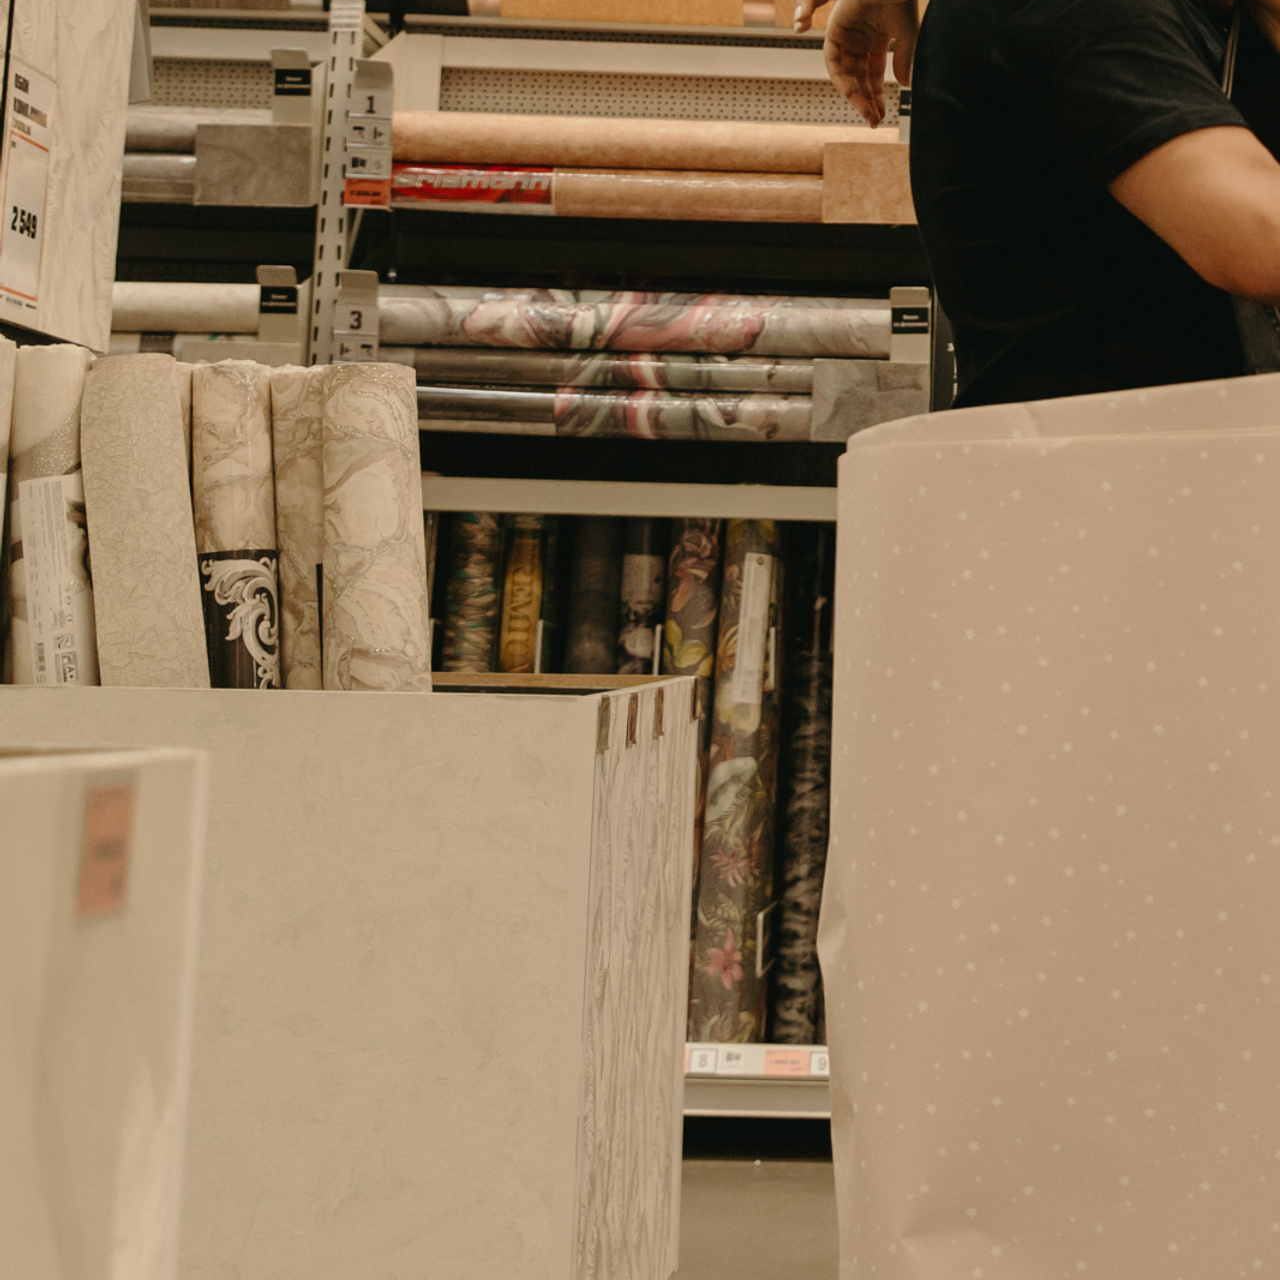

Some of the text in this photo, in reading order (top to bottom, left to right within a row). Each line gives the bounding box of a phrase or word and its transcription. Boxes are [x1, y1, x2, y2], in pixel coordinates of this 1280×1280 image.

[365, 96, 376, 114] 1
[350, 310, 363, 330] 3
[699, 1053, 708, 1068] 8
[818, 1056, 827, 1071] 9
